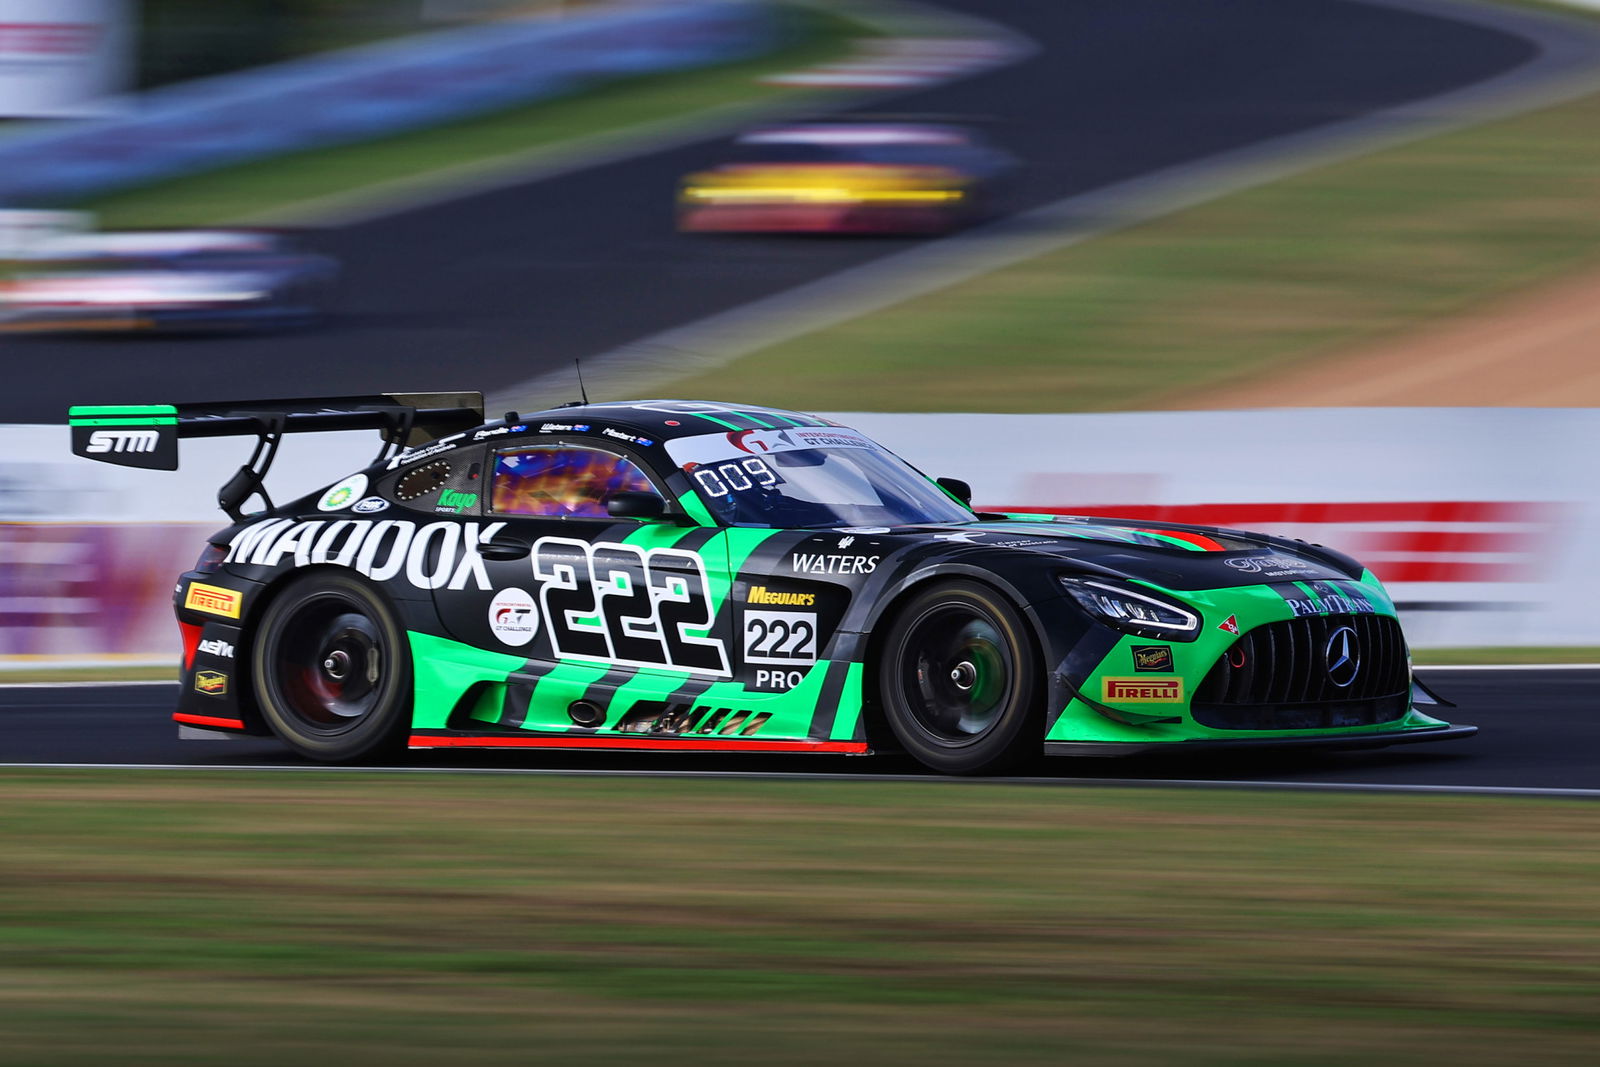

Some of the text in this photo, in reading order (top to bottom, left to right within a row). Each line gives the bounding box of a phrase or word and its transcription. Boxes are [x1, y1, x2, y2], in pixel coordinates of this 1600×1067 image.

[86, 430, 160, 453] STM
[694, 459, 776, 497] 009
[437, 489, 477, 514] Kayo
[222, 517, 508, 590] MADDOX
[792, 553, 880, 574] WATERS
[190, 588, 234, 612] PIRELLI
[531, 536, 733, 678] 222
[747, 618, 814, 660] 222
[756, 669, 803, 689] PRO
[1107, 681, 1179, 698] PIRELLI
